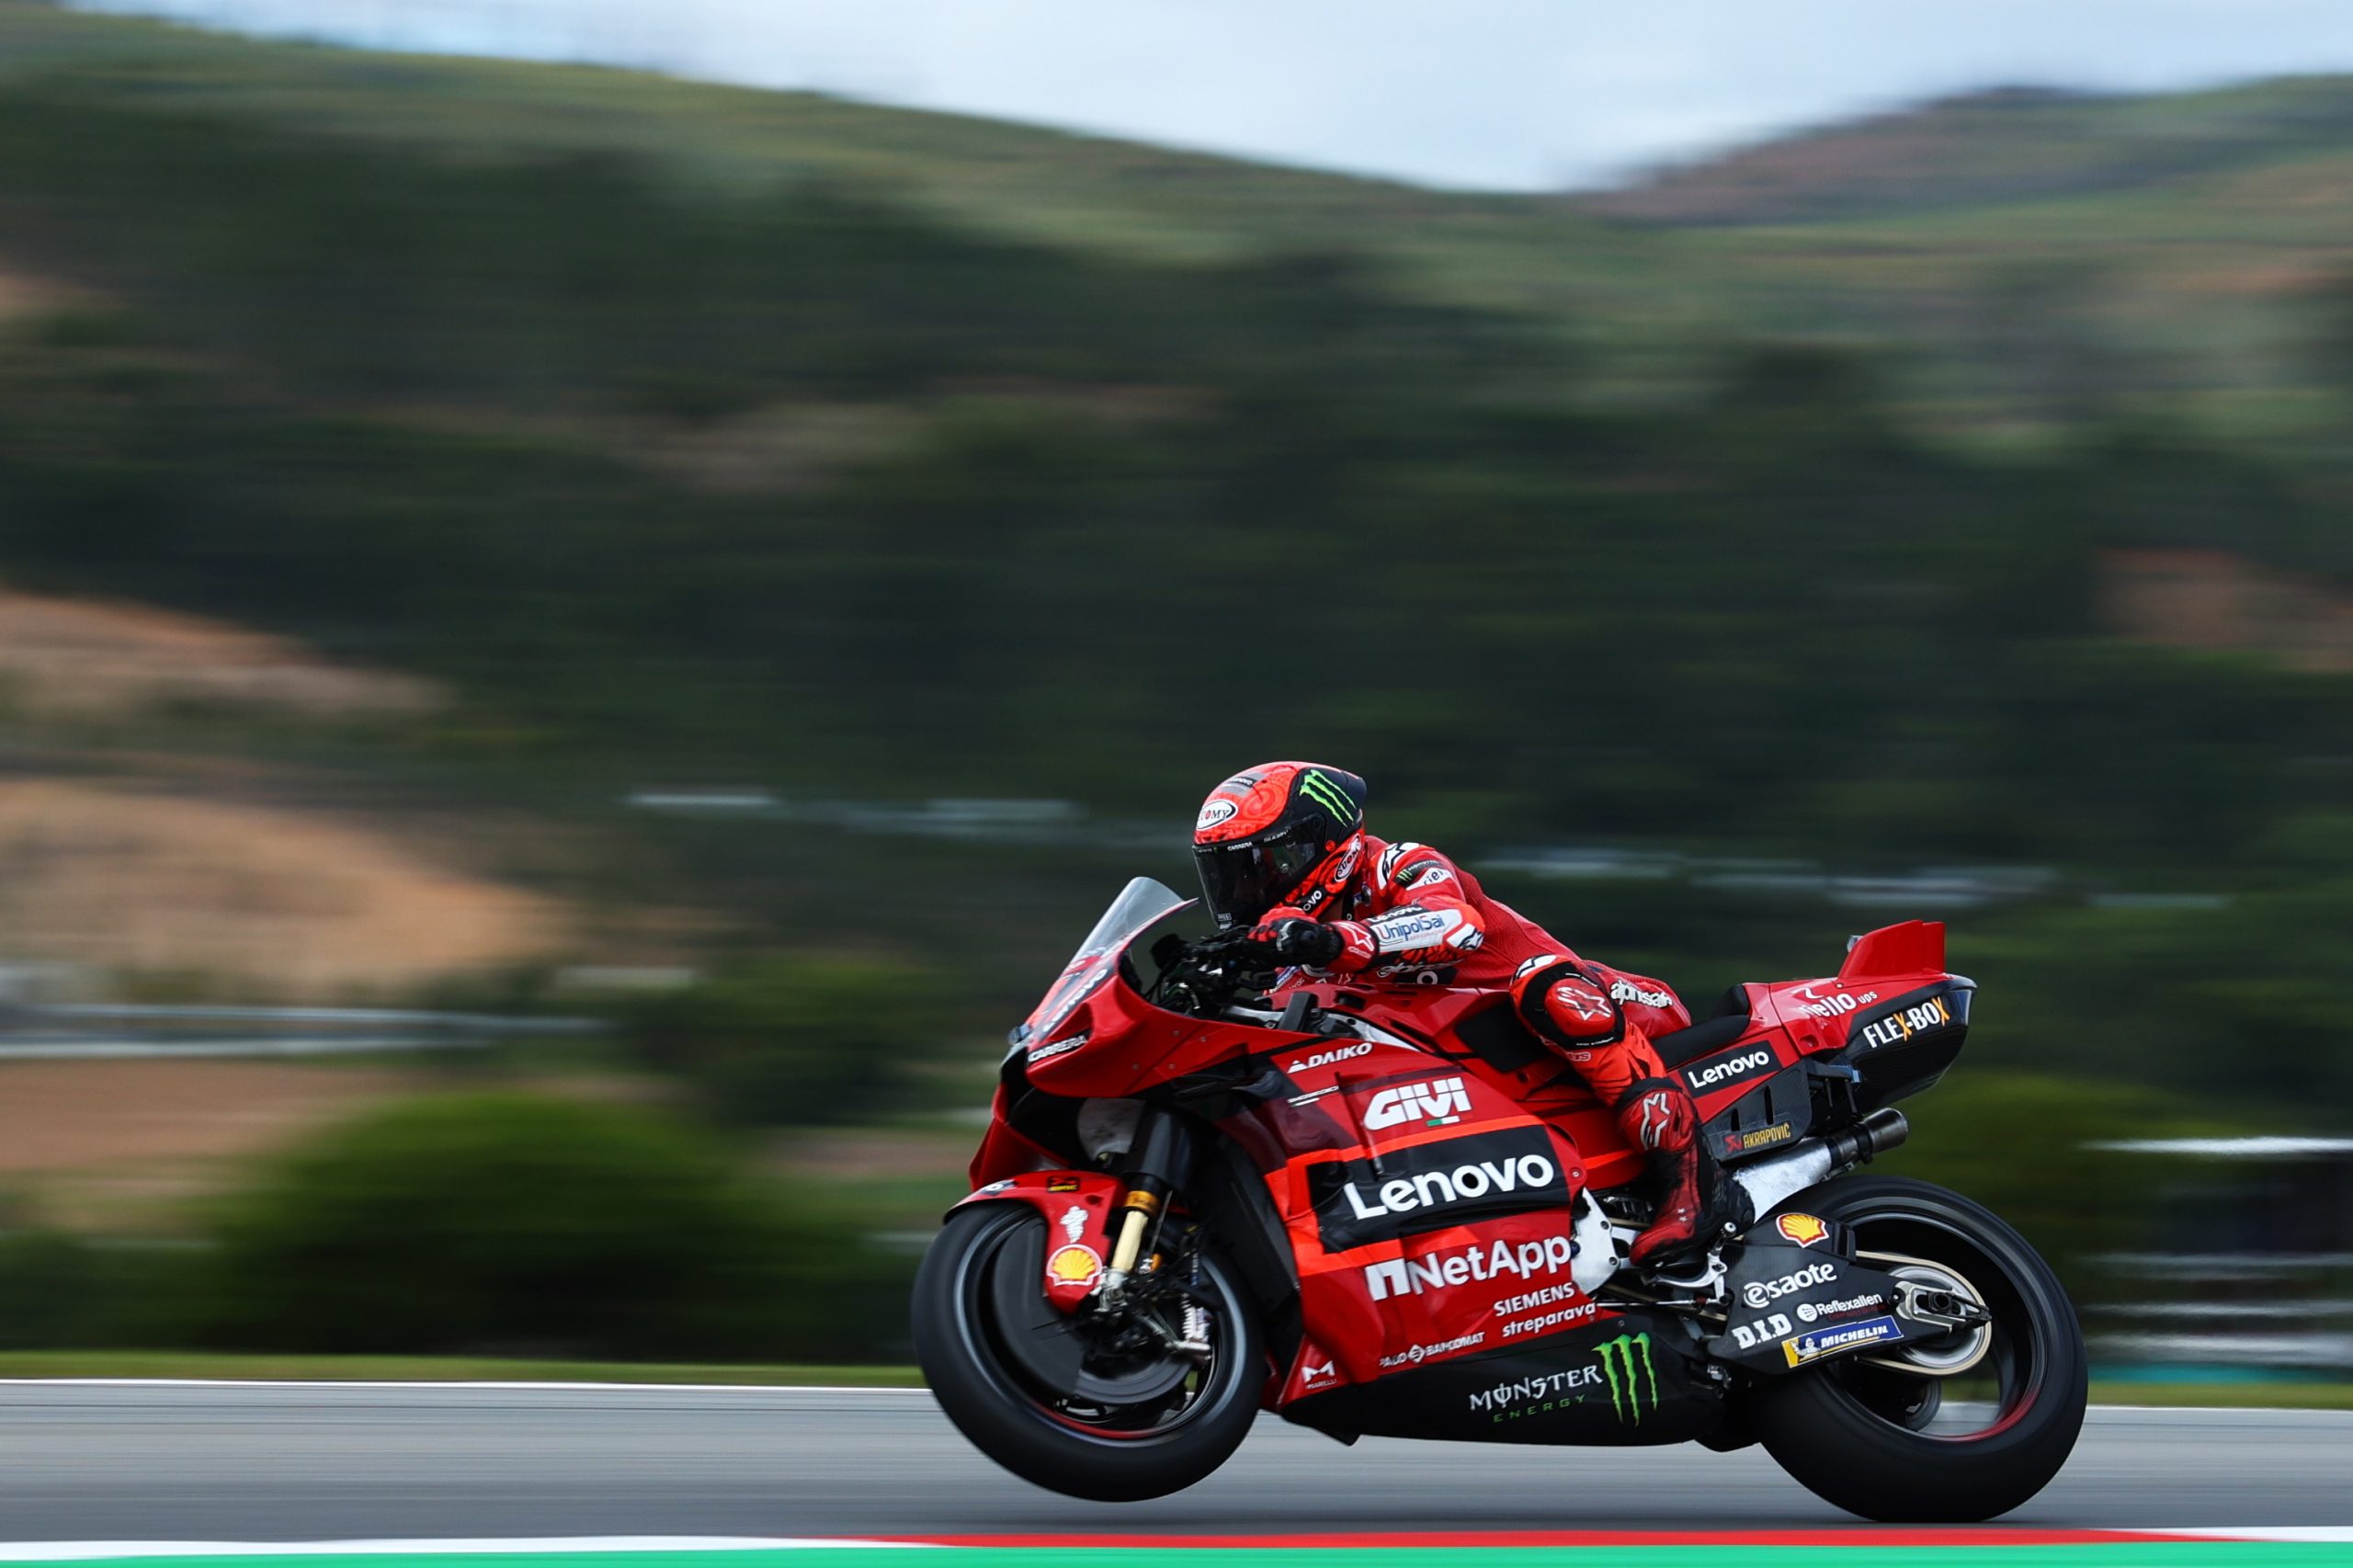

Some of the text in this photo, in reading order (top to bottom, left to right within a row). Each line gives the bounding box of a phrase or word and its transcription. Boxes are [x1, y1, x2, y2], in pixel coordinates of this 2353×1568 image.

[1379, 914, 1444, 941] UnipolSai
[1857, 991, 1878, 1005] ups
[1862, 995, 1950, 1049] FLEX-BOX
[1307, 1042, 1373, 1068] DAIKO
[1688, 1051, 1770, 1089] Lenovo
[1363, 1076, 1472, 1131] GIVI
[1343, 1154, 1554, 1220] Lenovo
[1407, 1235, 1572, 1296] NetApp
[1493, 1281, 1575, 1317] SIEMENS
[1743, 1263, 1837, 1309] esaote
[1502, 1301, 1597, 1337] streparava
[1815, 1293, 1883, 1316] Reflexallen
[1820, 1324, 1890, 1349] MICHELIN
[1469, 1364, 1604, 1411] MONSTER
[1493, 1393, 1586, 1423] ENERGY
